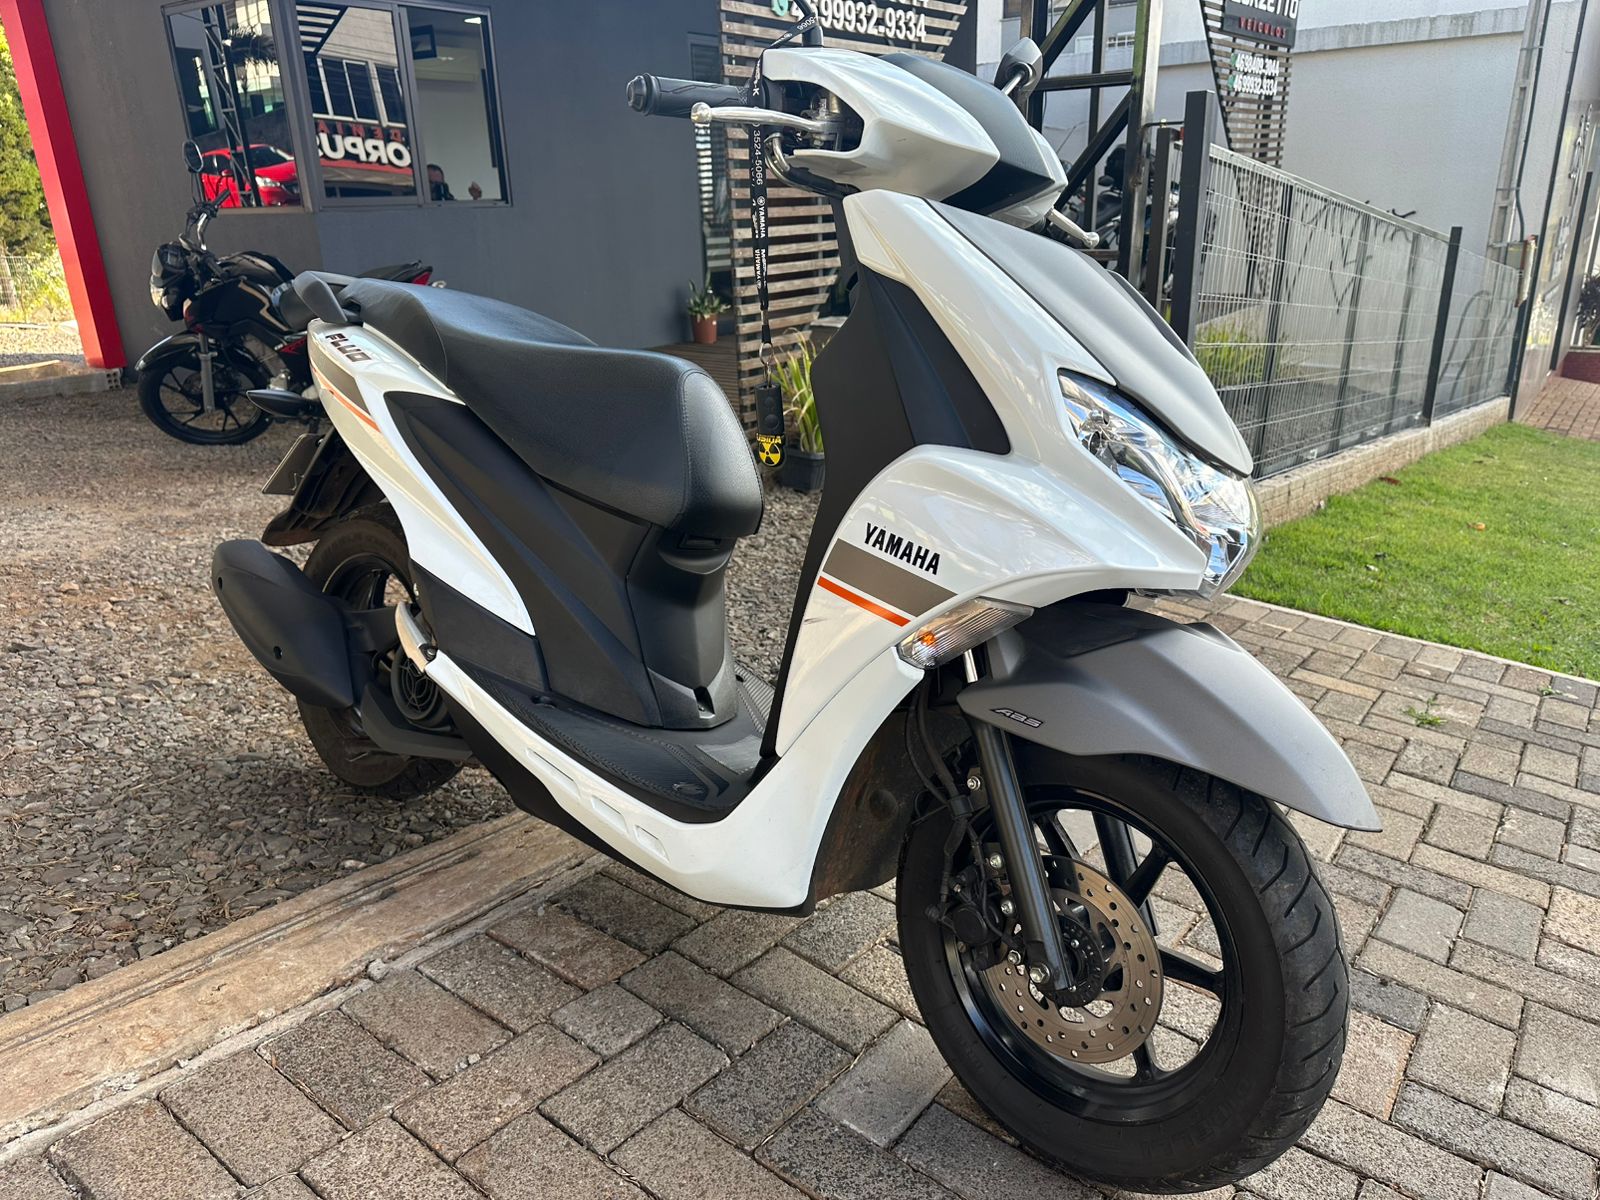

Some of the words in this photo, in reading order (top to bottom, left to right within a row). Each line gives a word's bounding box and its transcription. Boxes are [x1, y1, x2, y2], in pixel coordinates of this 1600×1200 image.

[758, 206, 766, 239] YAMAHA
[325, 332, 372, 363] FLUO
[864, 522, 941, 576] YAMAHA
[989, 707, 1044, 729] ABS
